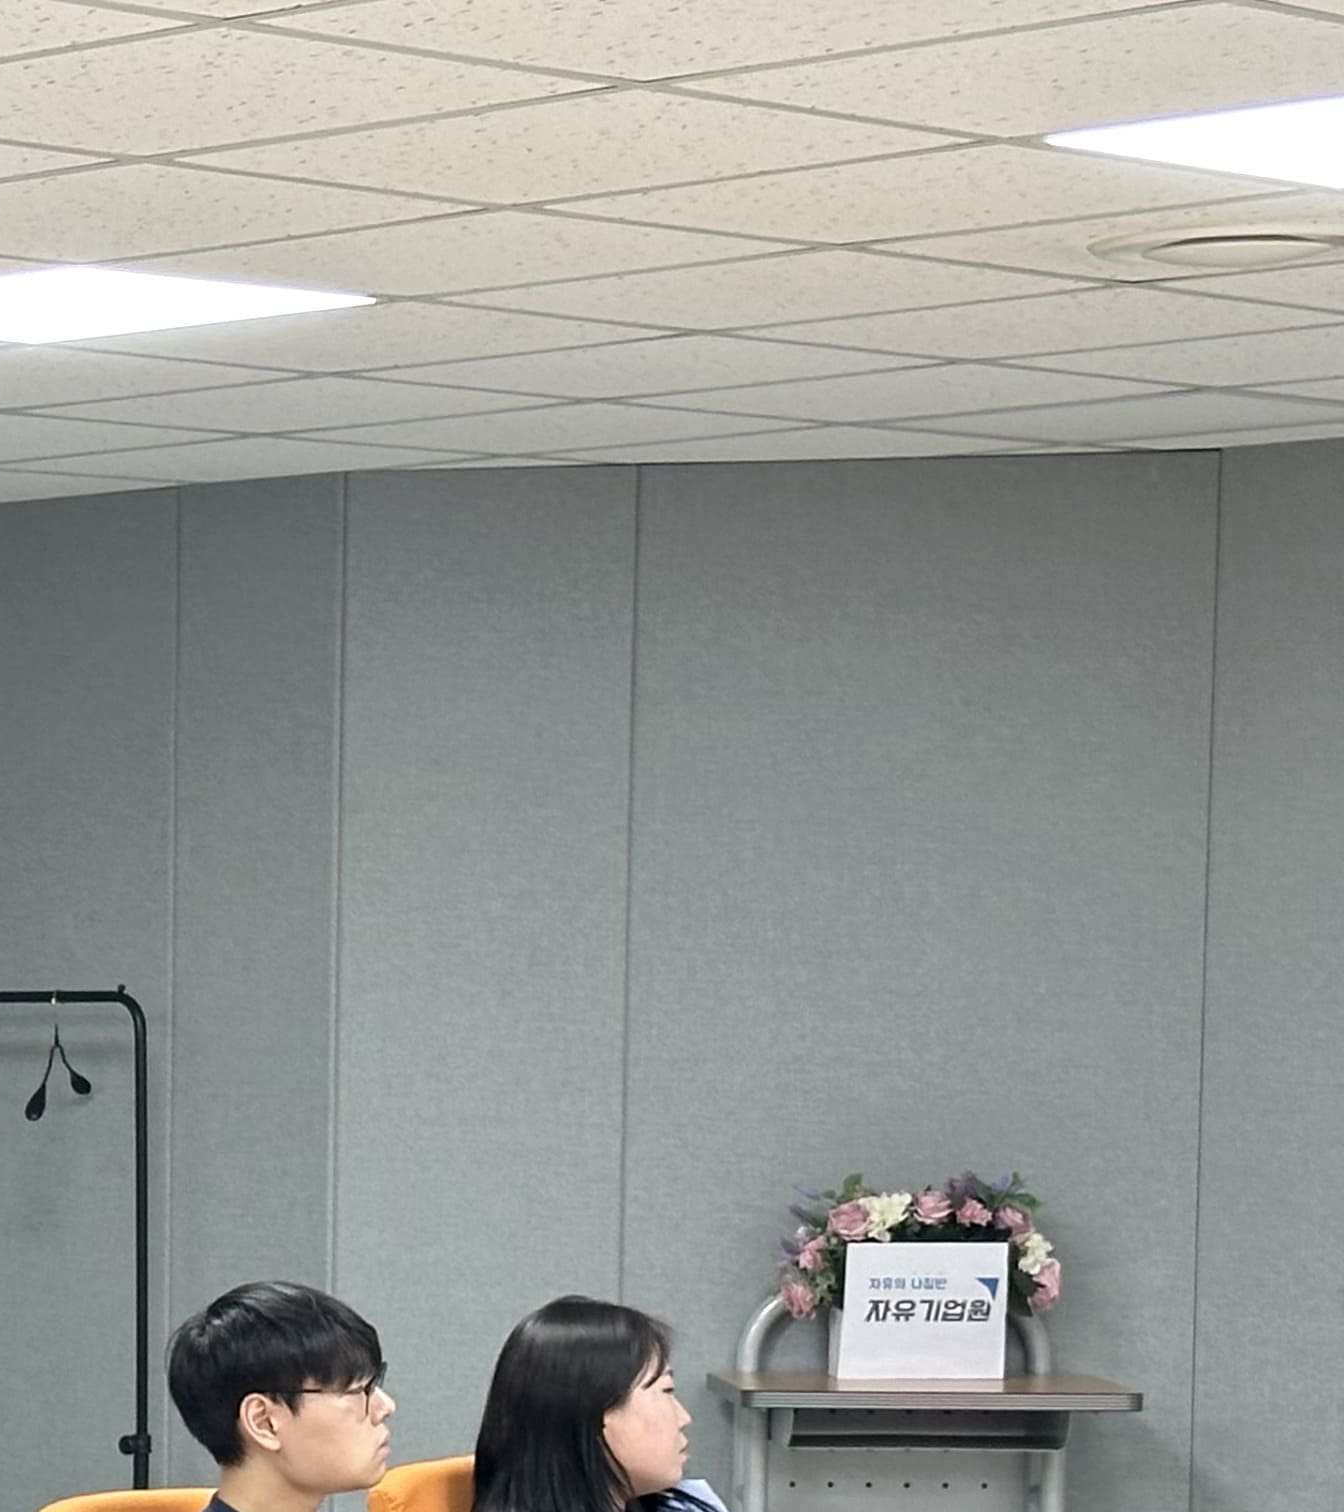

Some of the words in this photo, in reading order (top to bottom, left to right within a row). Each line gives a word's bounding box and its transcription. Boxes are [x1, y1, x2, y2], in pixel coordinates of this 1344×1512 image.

[868, 1277, 906, 1290] 자유의
[911, 1277, 947, 1290] 나침반
[865, 1300, 992, 1323] 자유기업원
